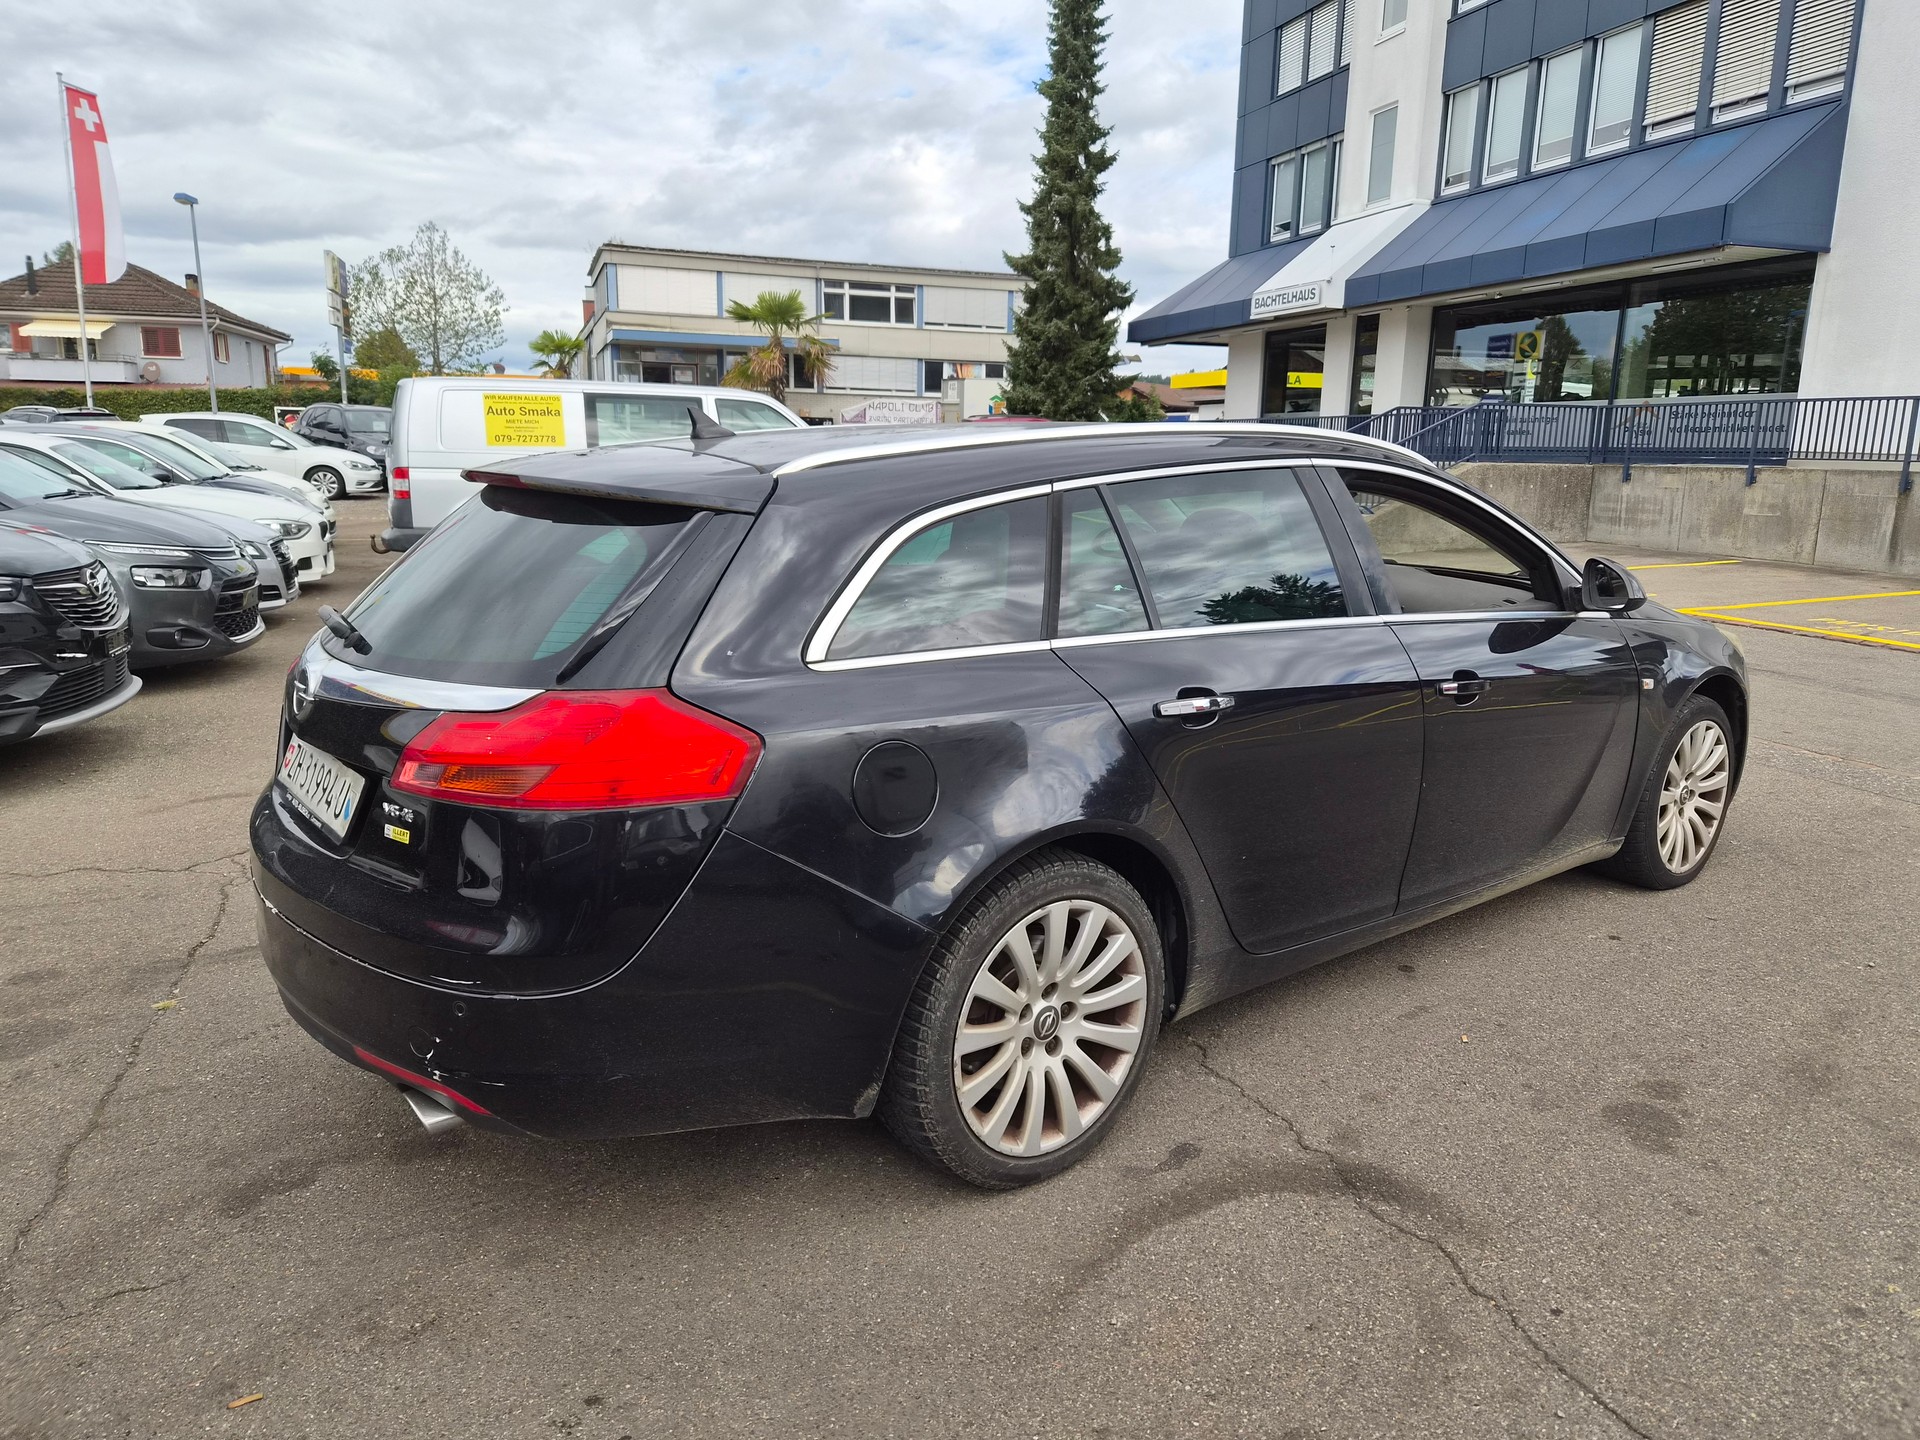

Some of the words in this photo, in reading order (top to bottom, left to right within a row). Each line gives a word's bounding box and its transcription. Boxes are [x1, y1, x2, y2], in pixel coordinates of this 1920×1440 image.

[1254, 288, 1316, 309] BACHTELHAUS
[486, 405, 516, 417] Auto
[519, 406, 561, 417] Smaka
[868, 401, 904, 412] NAPOLI
[908, 402, 934, 413] CLUB
[494, 434, 557, 443] 079-7273778
